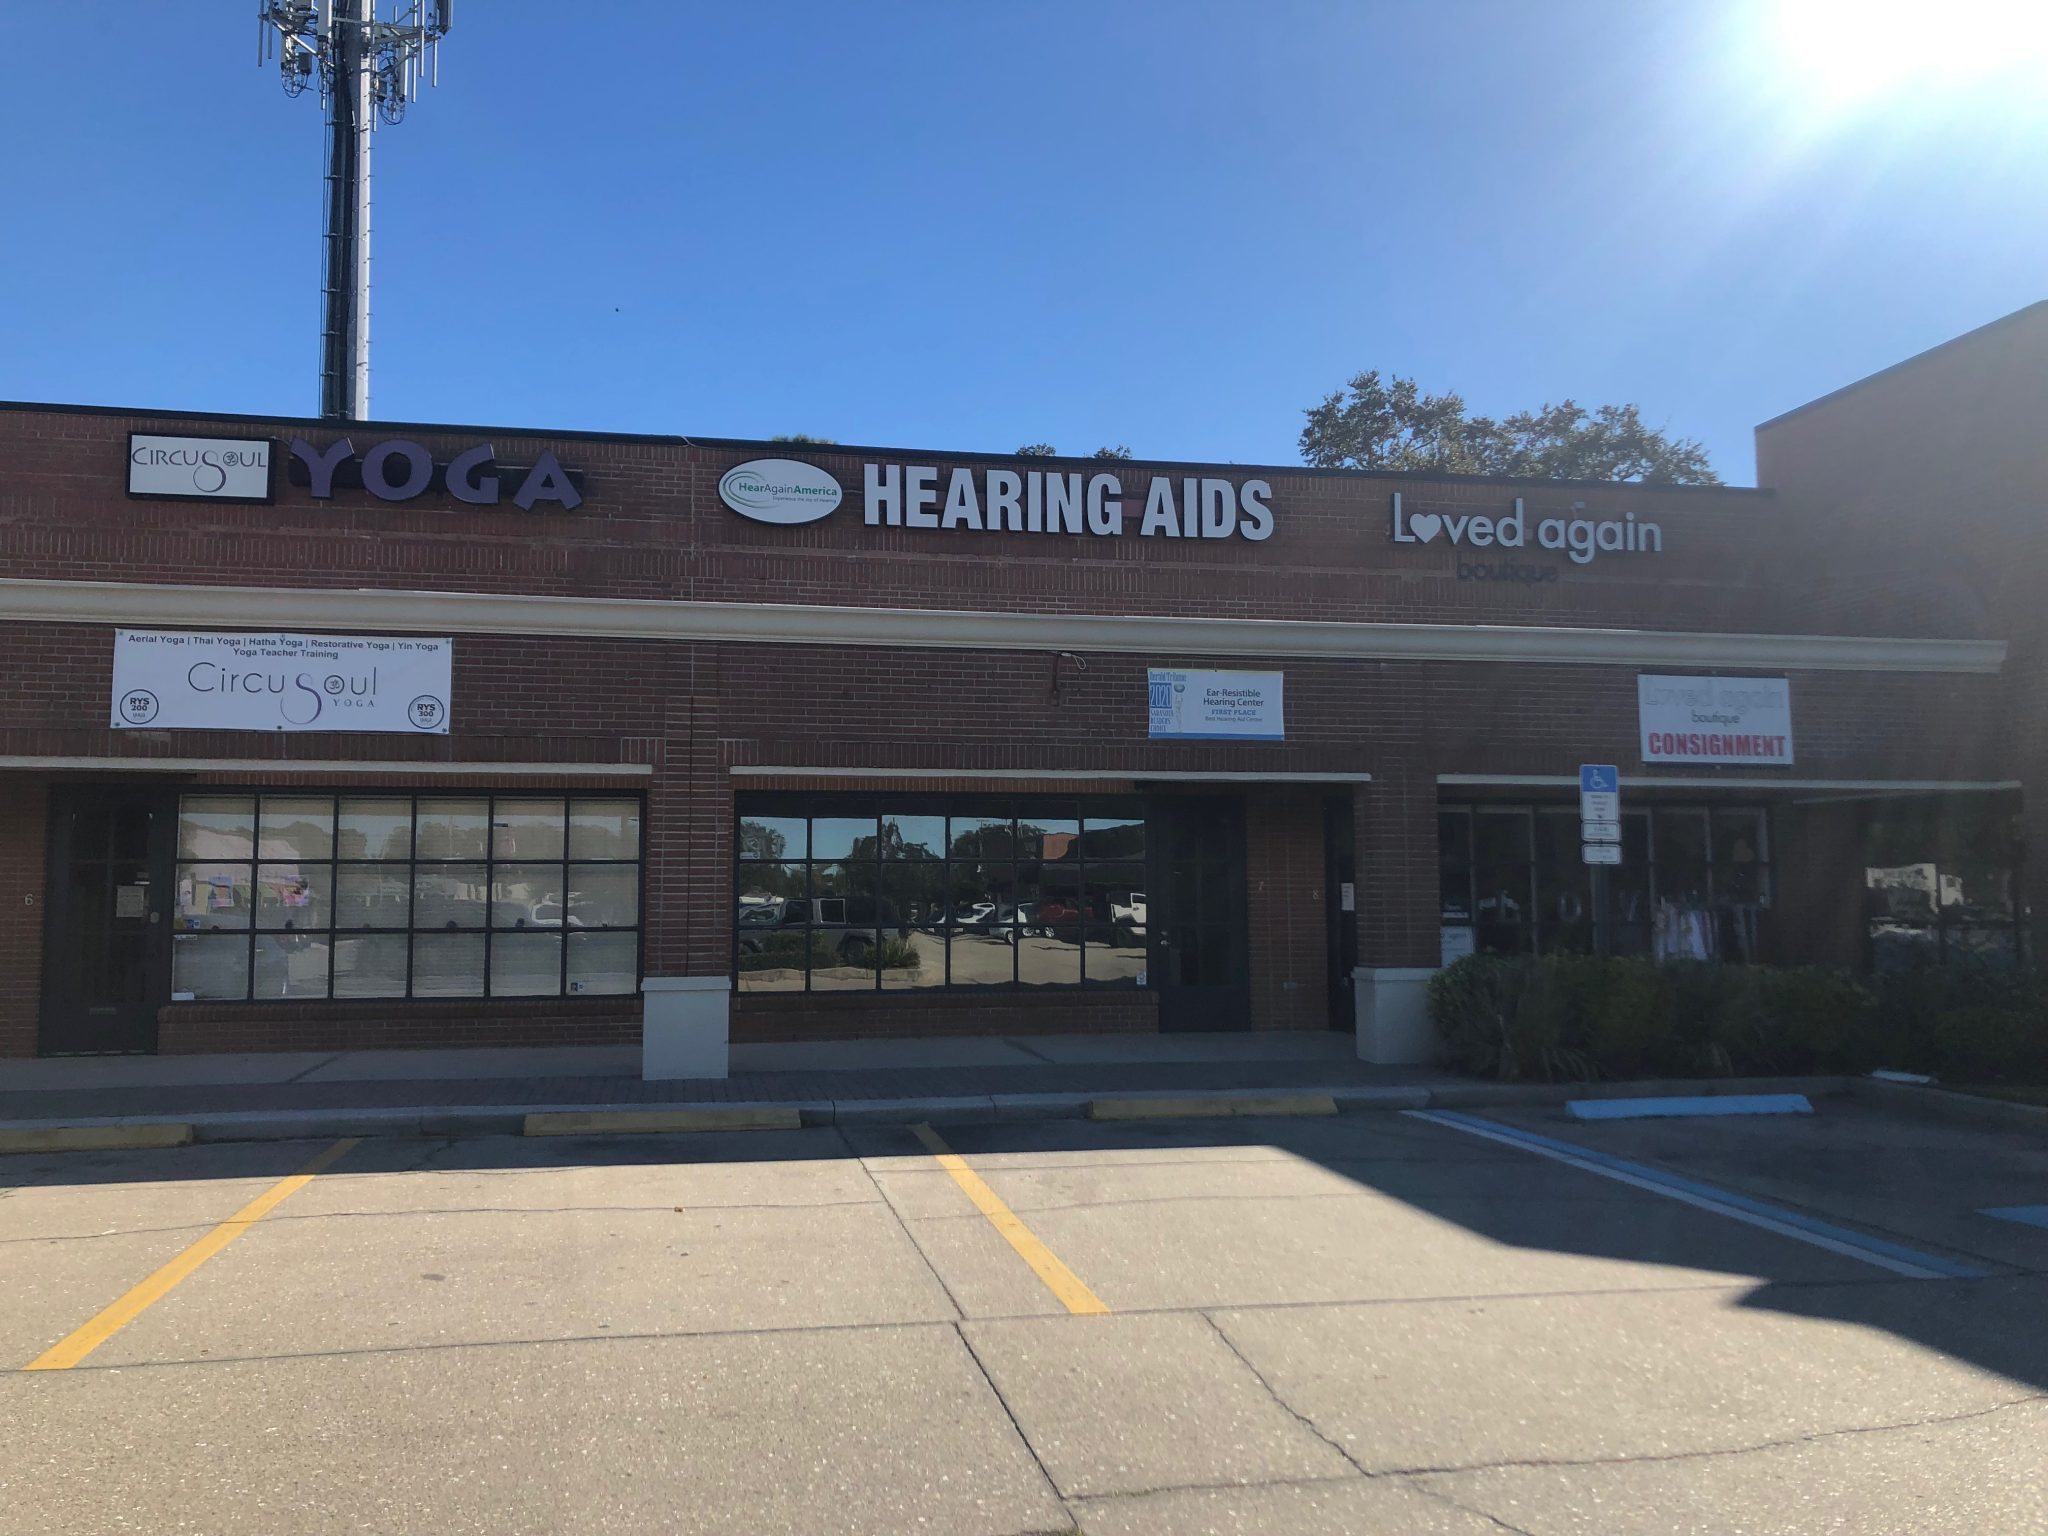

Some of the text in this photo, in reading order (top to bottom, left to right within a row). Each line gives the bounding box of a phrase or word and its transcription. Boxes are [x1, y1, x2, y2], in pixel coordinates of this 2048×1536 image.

[290, 437, 583, 511] YOGA
[864, 463, 1274, 541] HEARING AIDS
[1538, 511, 1662, 563] again
[128, 634, 439, 652] Aerial Yoga Thai Yoga Hatha Yoga Restorative Yoga Yin Yoga
[233, 647, 339, 660] Yoga Teacher Training
[1150, 684, 1172, 707] 2020
[1206, 688, 1261, 698] Ear-Resistible
[130, 697, 150, 705] RYS
[332, 698, 375, 708] YOGA
[417, 703, 436, 711] RYS
[1203, 697, 1265, 708] Hearing Center
[1691, 709, 1741, 726] boutique
[1648, 732, 1786, 756] CONSIGNMENT
[24, 893, 34, 906] 6
[1312, 889, 1319, 900] 8
